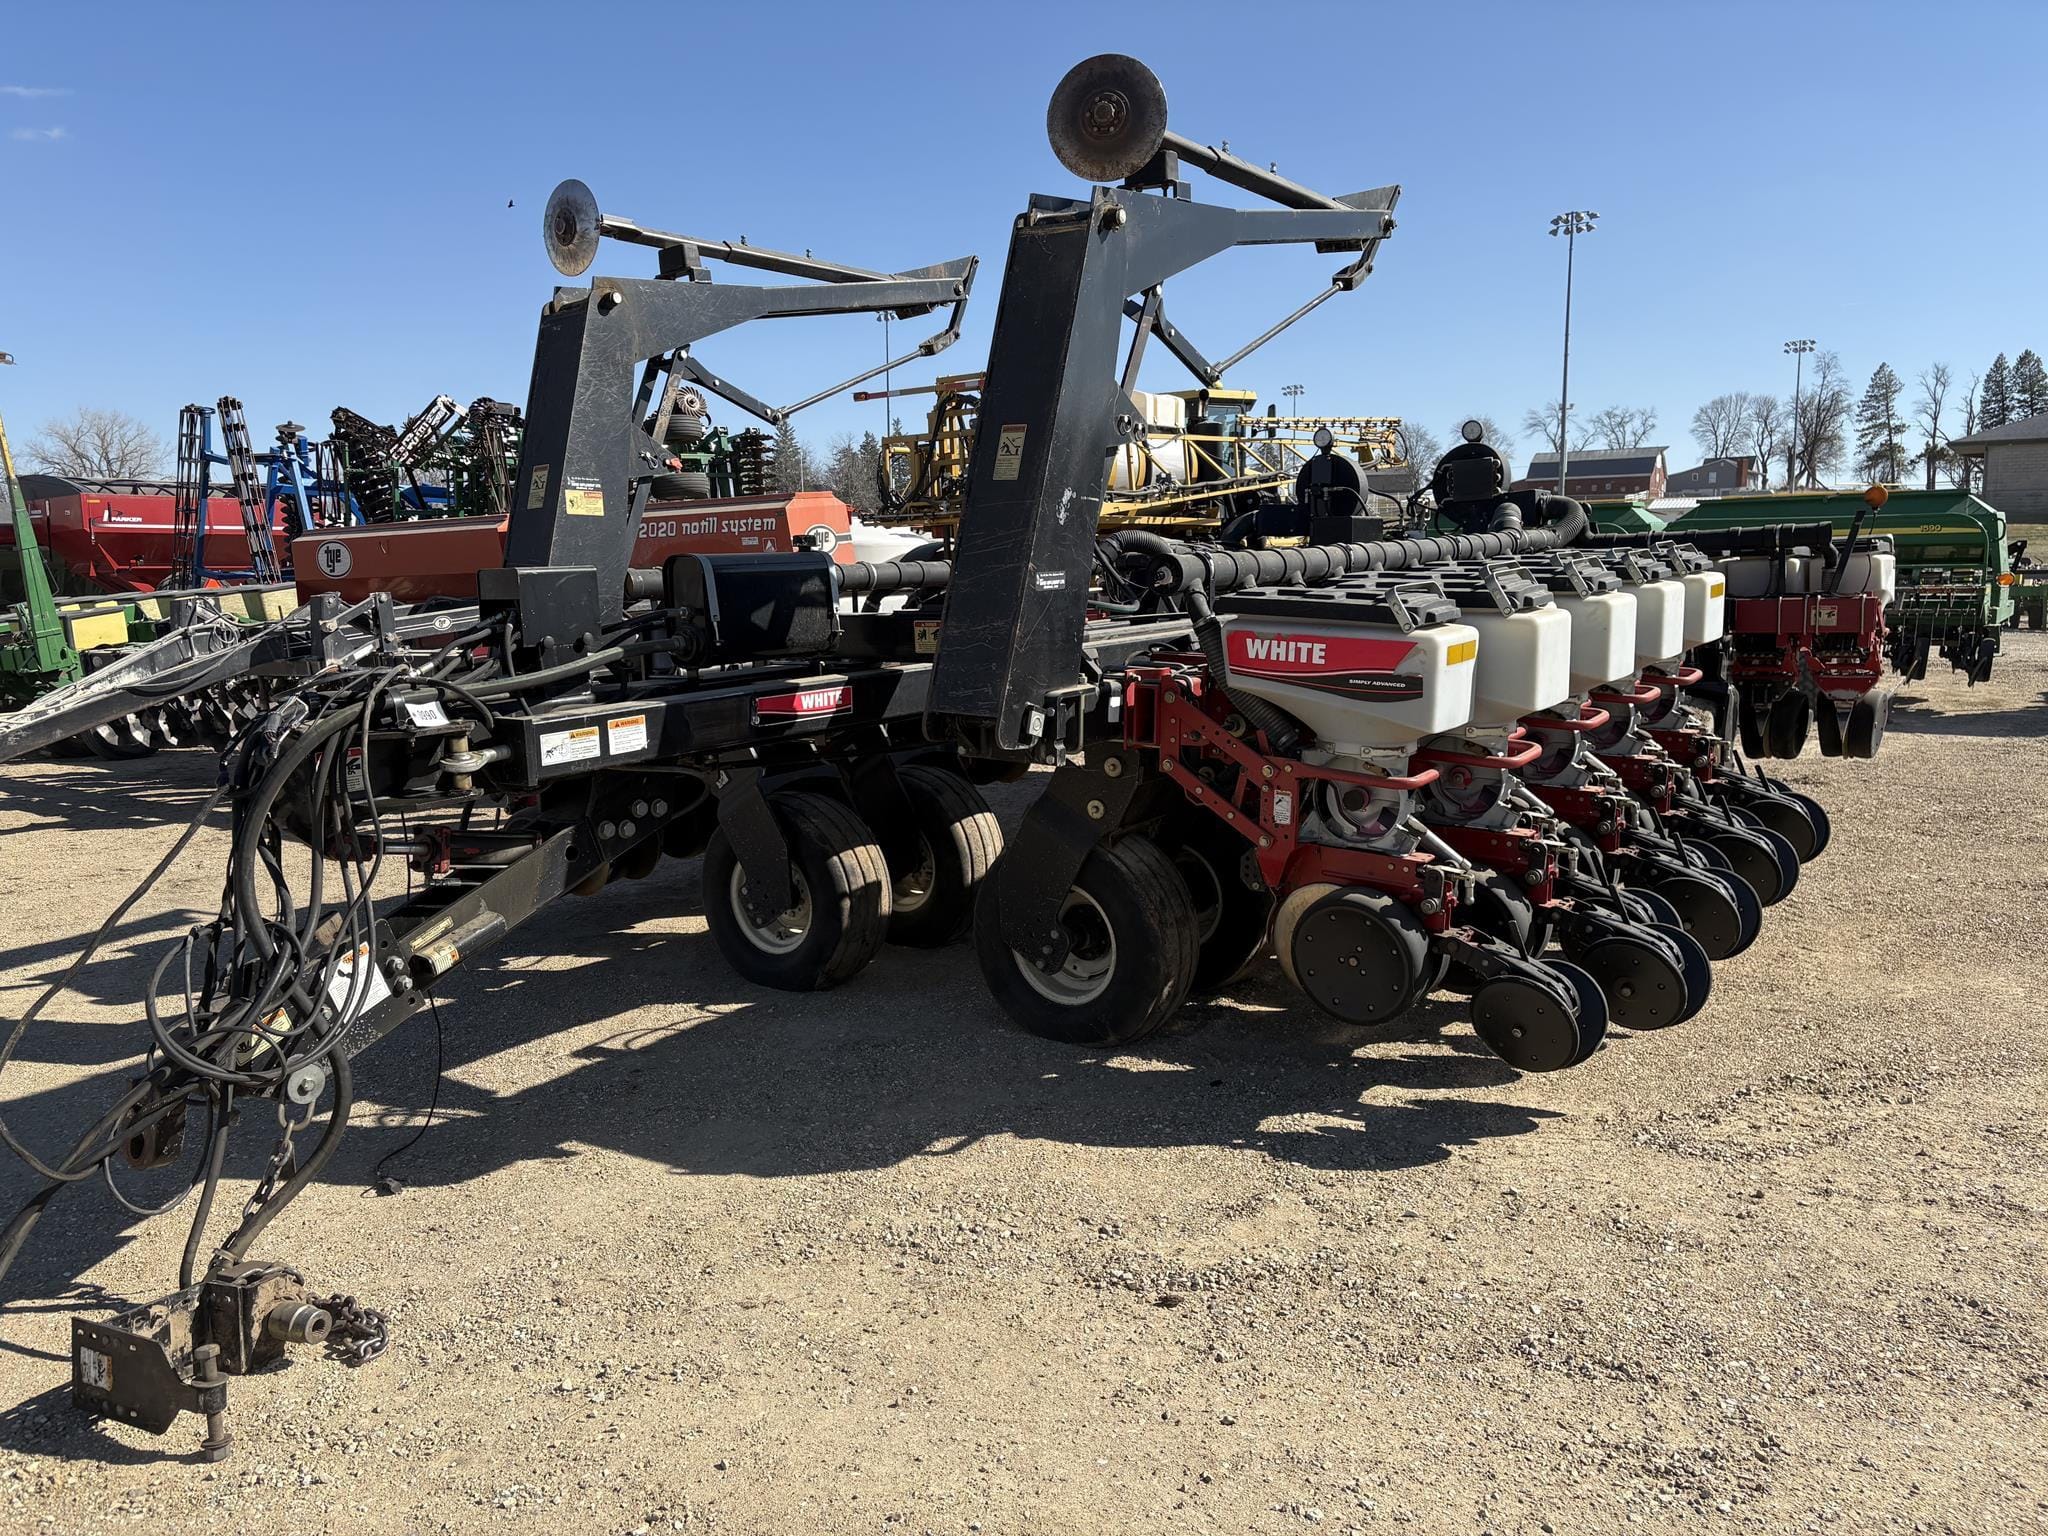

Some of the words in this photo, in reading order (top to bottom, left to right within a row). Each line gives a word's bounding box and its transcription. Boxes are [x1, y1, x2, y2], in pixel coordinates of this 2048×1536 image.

[639, 521, 676, 538] 2020
[682, 516, 717, 536] notill
[721, 517, 776, 536] system
[814, 529, 830, 551] tye
[324, 545, 342, 573] tye
[1245, 637, 1327, 665] WHITE
[1348, 678, 1372, 686] SIMPLY
[800, 689, 843, 710] WHITE
